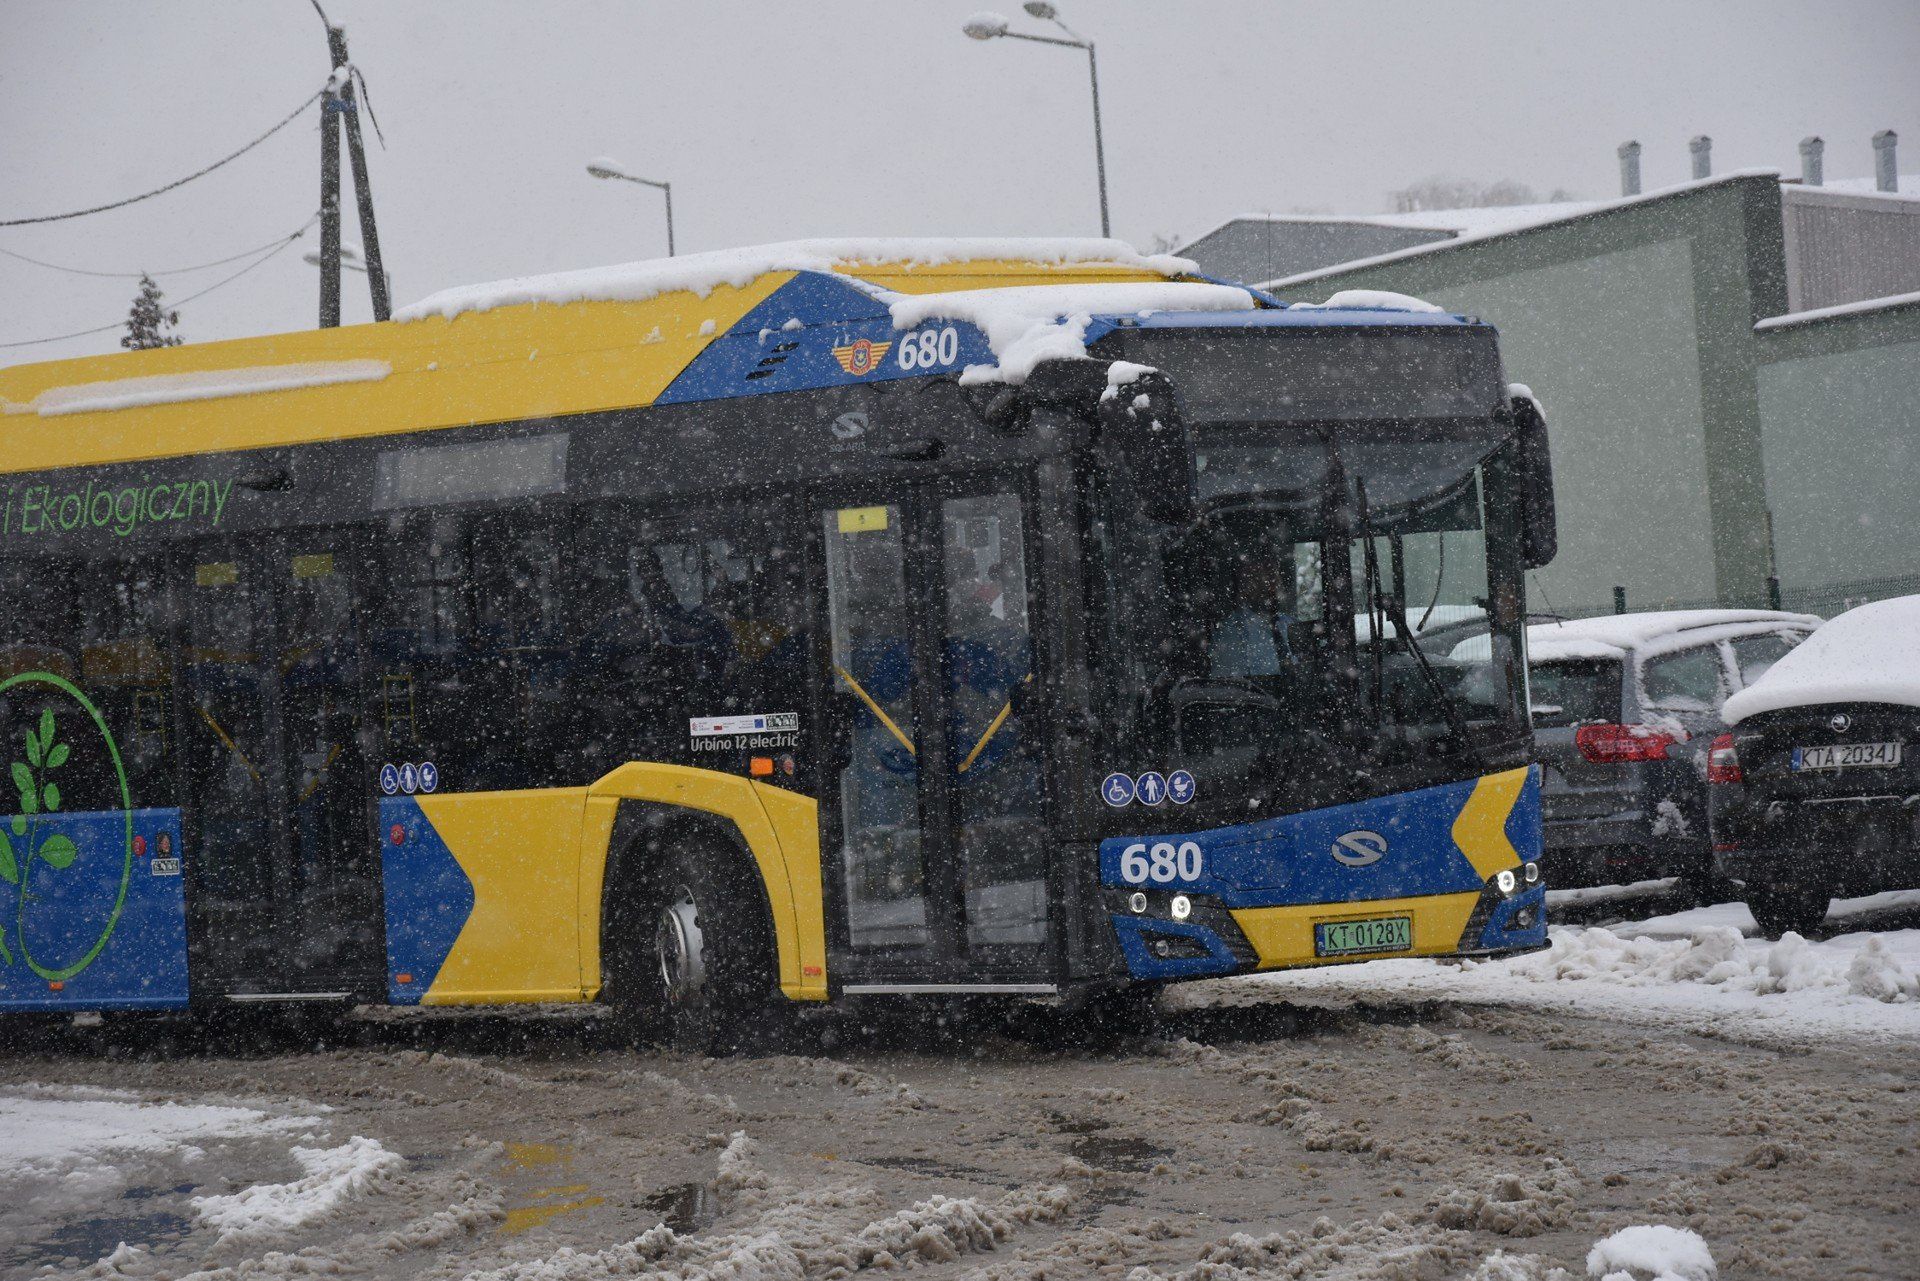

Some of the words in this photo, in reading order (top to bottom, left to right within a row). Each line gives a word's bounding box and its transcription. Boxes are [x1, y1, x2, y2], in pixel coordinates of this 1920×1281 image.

[899, 327, 958, 370] 680
[3, 489, 14, 534] i
[22, 474, 233, 536] Ekologiczny
[690, 736, 732, 752] Urbino
[735, 735, 747, 749] 12
[750, 731, 799, 748] electric
[1801, 749, 1835, 767] KTA
[1841, 744, 1896, 765] 2034J
[1120, 842, 1202, 883] 680
[1327, 926, 1349, 949] KT
[1355, 921, 1405, 947] 0128X
